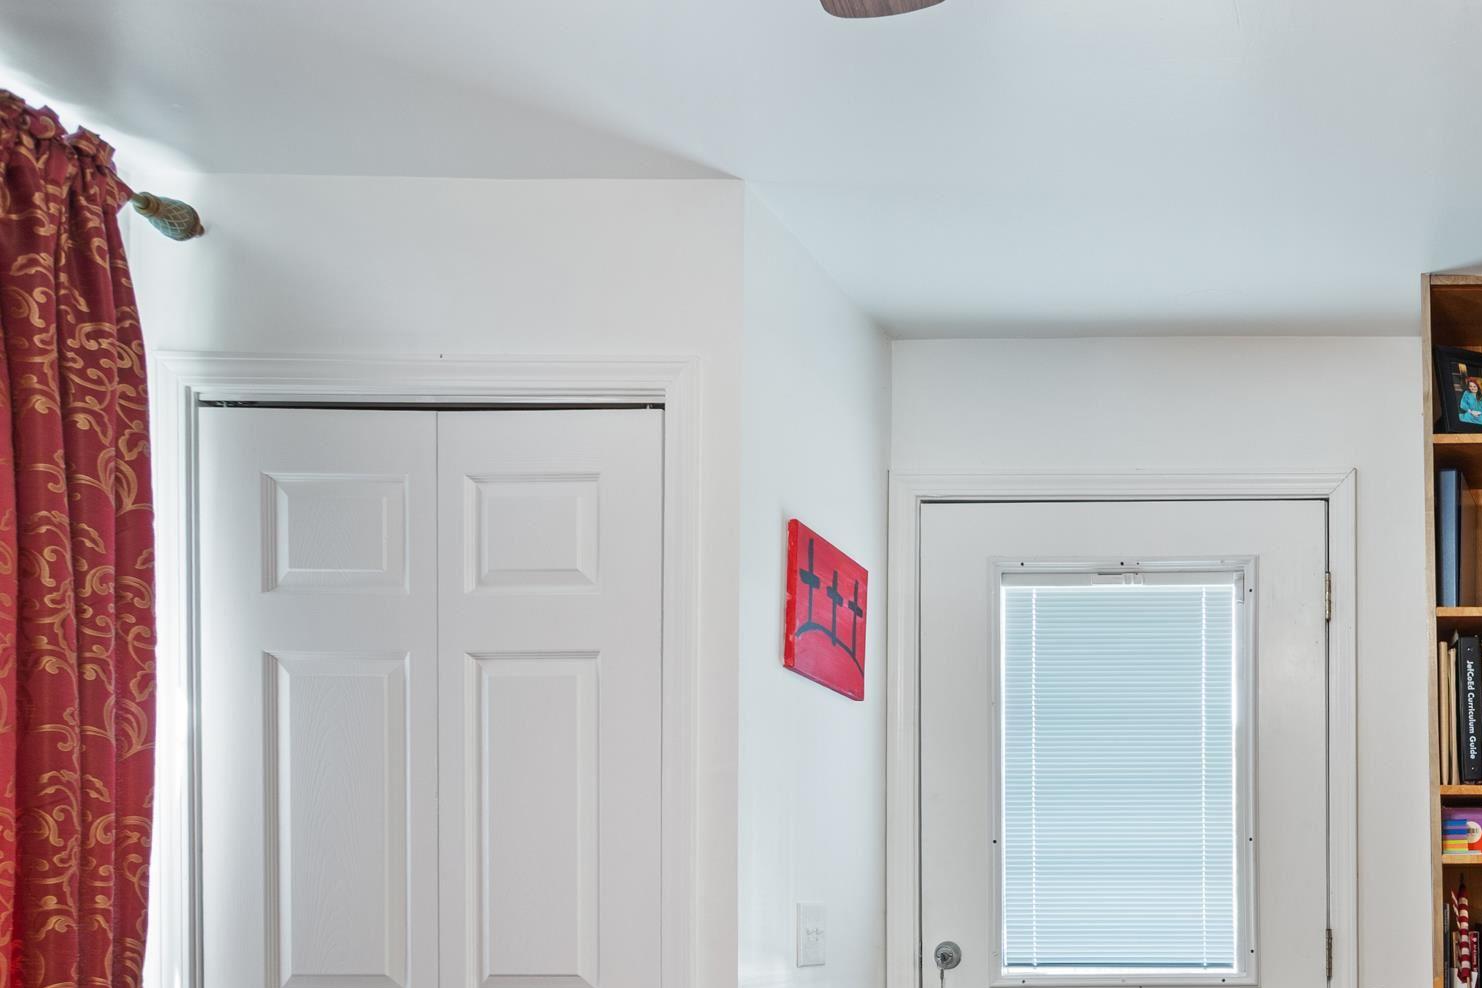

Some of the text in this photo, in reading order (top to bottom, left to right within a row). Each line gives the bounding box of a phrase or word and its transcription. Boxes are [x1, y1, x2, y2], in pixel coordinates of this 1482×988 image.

[1467, 660, 1477, 760] JefCoEd Curriculum Guide
